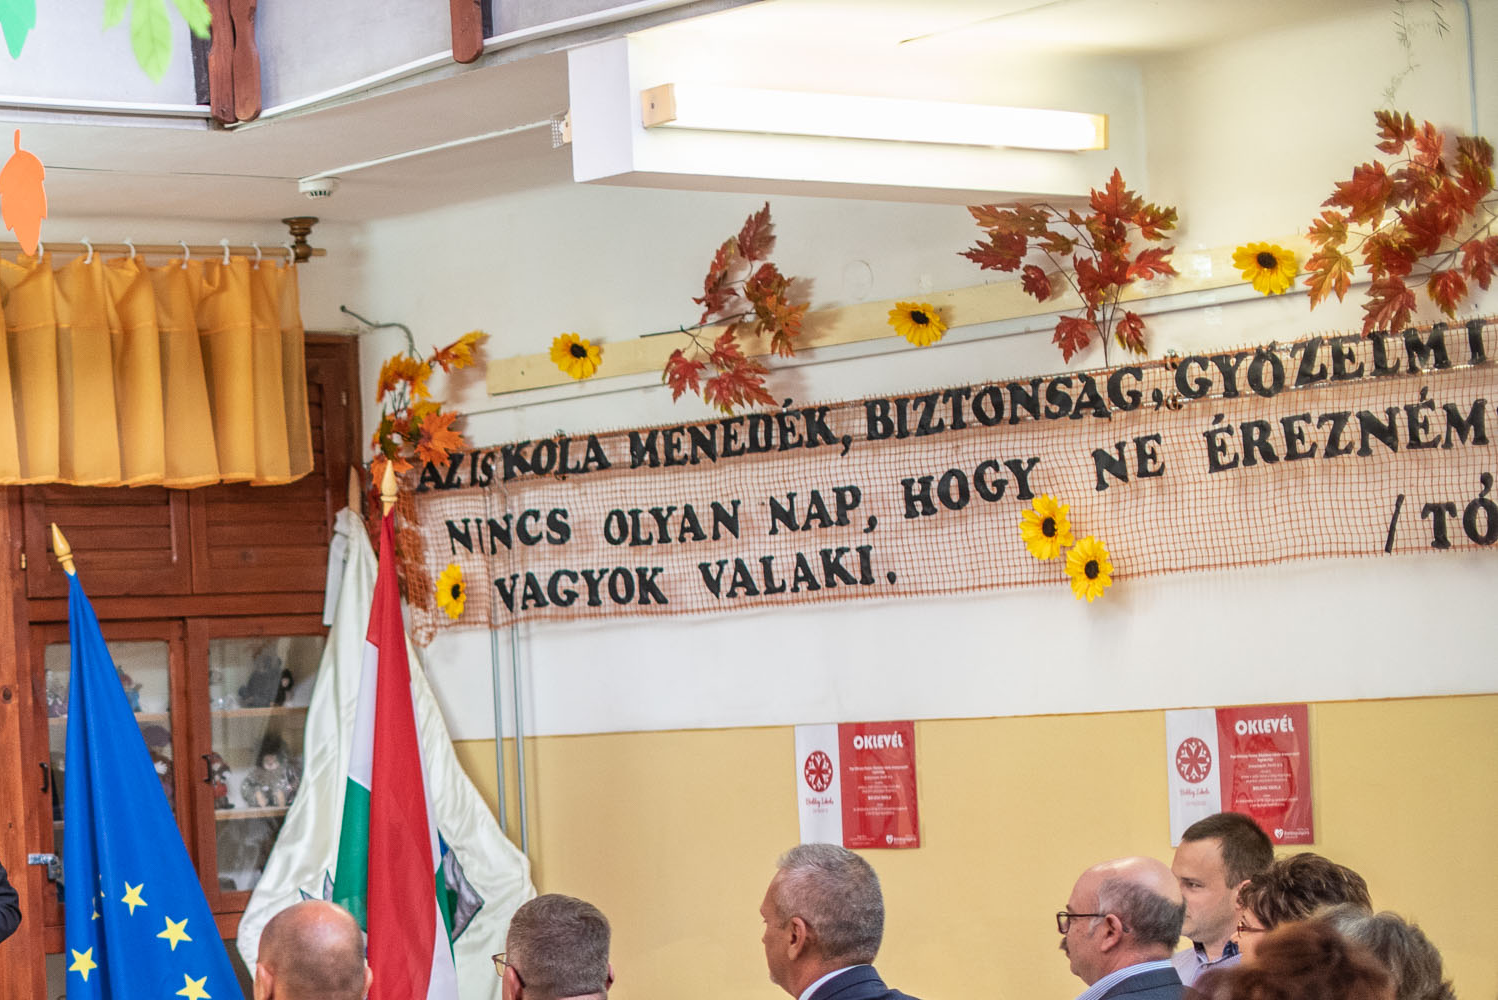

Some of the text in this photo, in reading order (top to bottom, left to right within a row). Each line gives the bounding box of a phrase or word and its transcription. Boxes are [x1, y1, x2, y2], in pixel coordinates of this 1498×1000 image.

[470, 434, 612, 487] ISKOLA
[629, 398, 852, 468] MENEDÉK,
[446, 508, 572, 555] NINCS
[604, 499, 741, 546] OLYAN
[769, 485, 878, 535] NAP,
[902, 456, 1040, 519] HOGY
[1091, 433, 1166, 491] NE
[494, 545, 897, 613] VAGYOK VALAKI.
[853, 730, 904, 750] OKLEVÉL
[1234, 714, 1294, 736] OKLEVÉL
